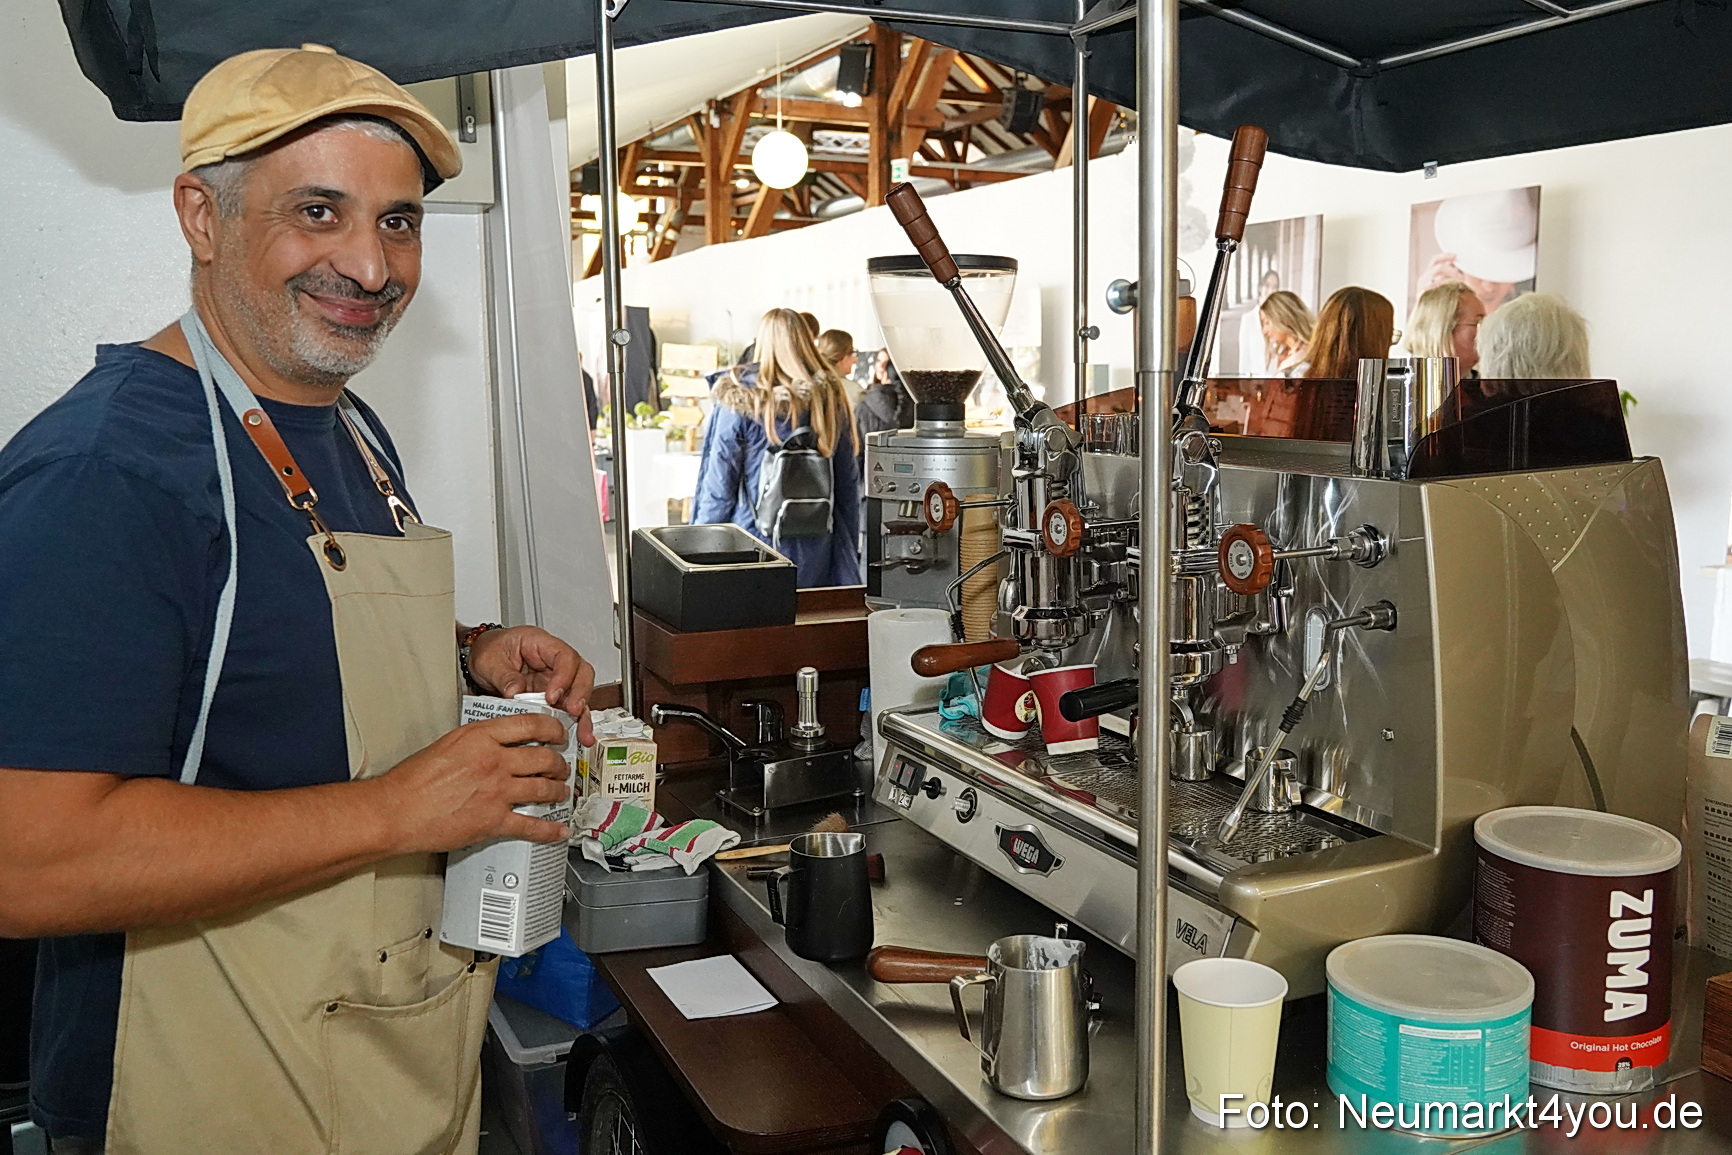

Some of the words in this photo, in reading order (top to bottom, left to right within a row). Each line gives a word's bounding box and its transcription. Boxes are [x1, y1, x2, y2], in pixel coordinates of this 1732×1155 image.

[472, 701, 495, 711] HALLO
[497, 705, 514, 713] FAN
[628, 751, 655, 766] Bio
[607, 782, 651, 794] H-MILCH
[1012, 837, 1040, 864] WEGA
[1175, 917, 1208, 956] VELA
[1603, 889, 1654, 1022] ZUMA
[1570, 1041, 1610, 1053] Original
[1612, 1043, 1629, 1052] Hot
[1630, 1035, 1662, 1051] Chocolate
